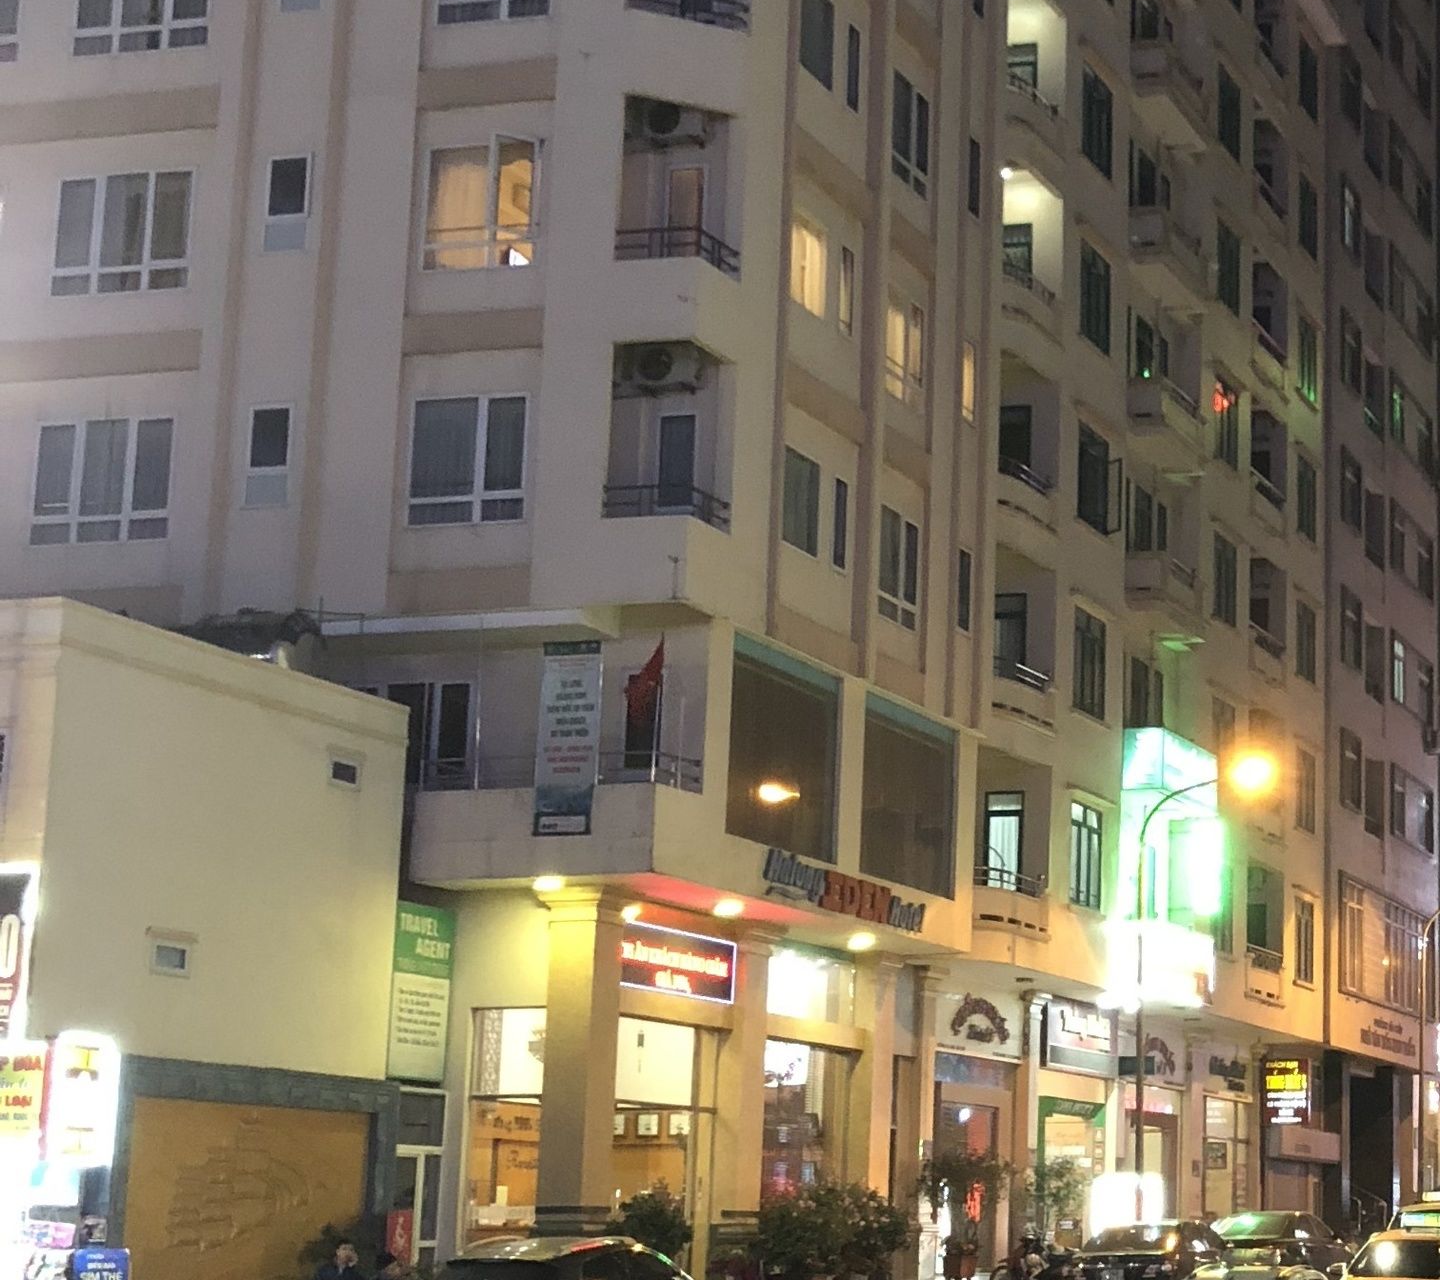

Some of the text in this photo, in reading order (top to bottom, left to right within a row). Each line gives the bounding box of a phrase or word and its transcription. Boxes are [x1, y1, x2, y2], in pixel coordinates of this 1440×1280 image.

[818, 870, 891, 924] EDEN
[400, 912, 439, 937] TRAVEL
[415, 937, 451, 960] AGENT
